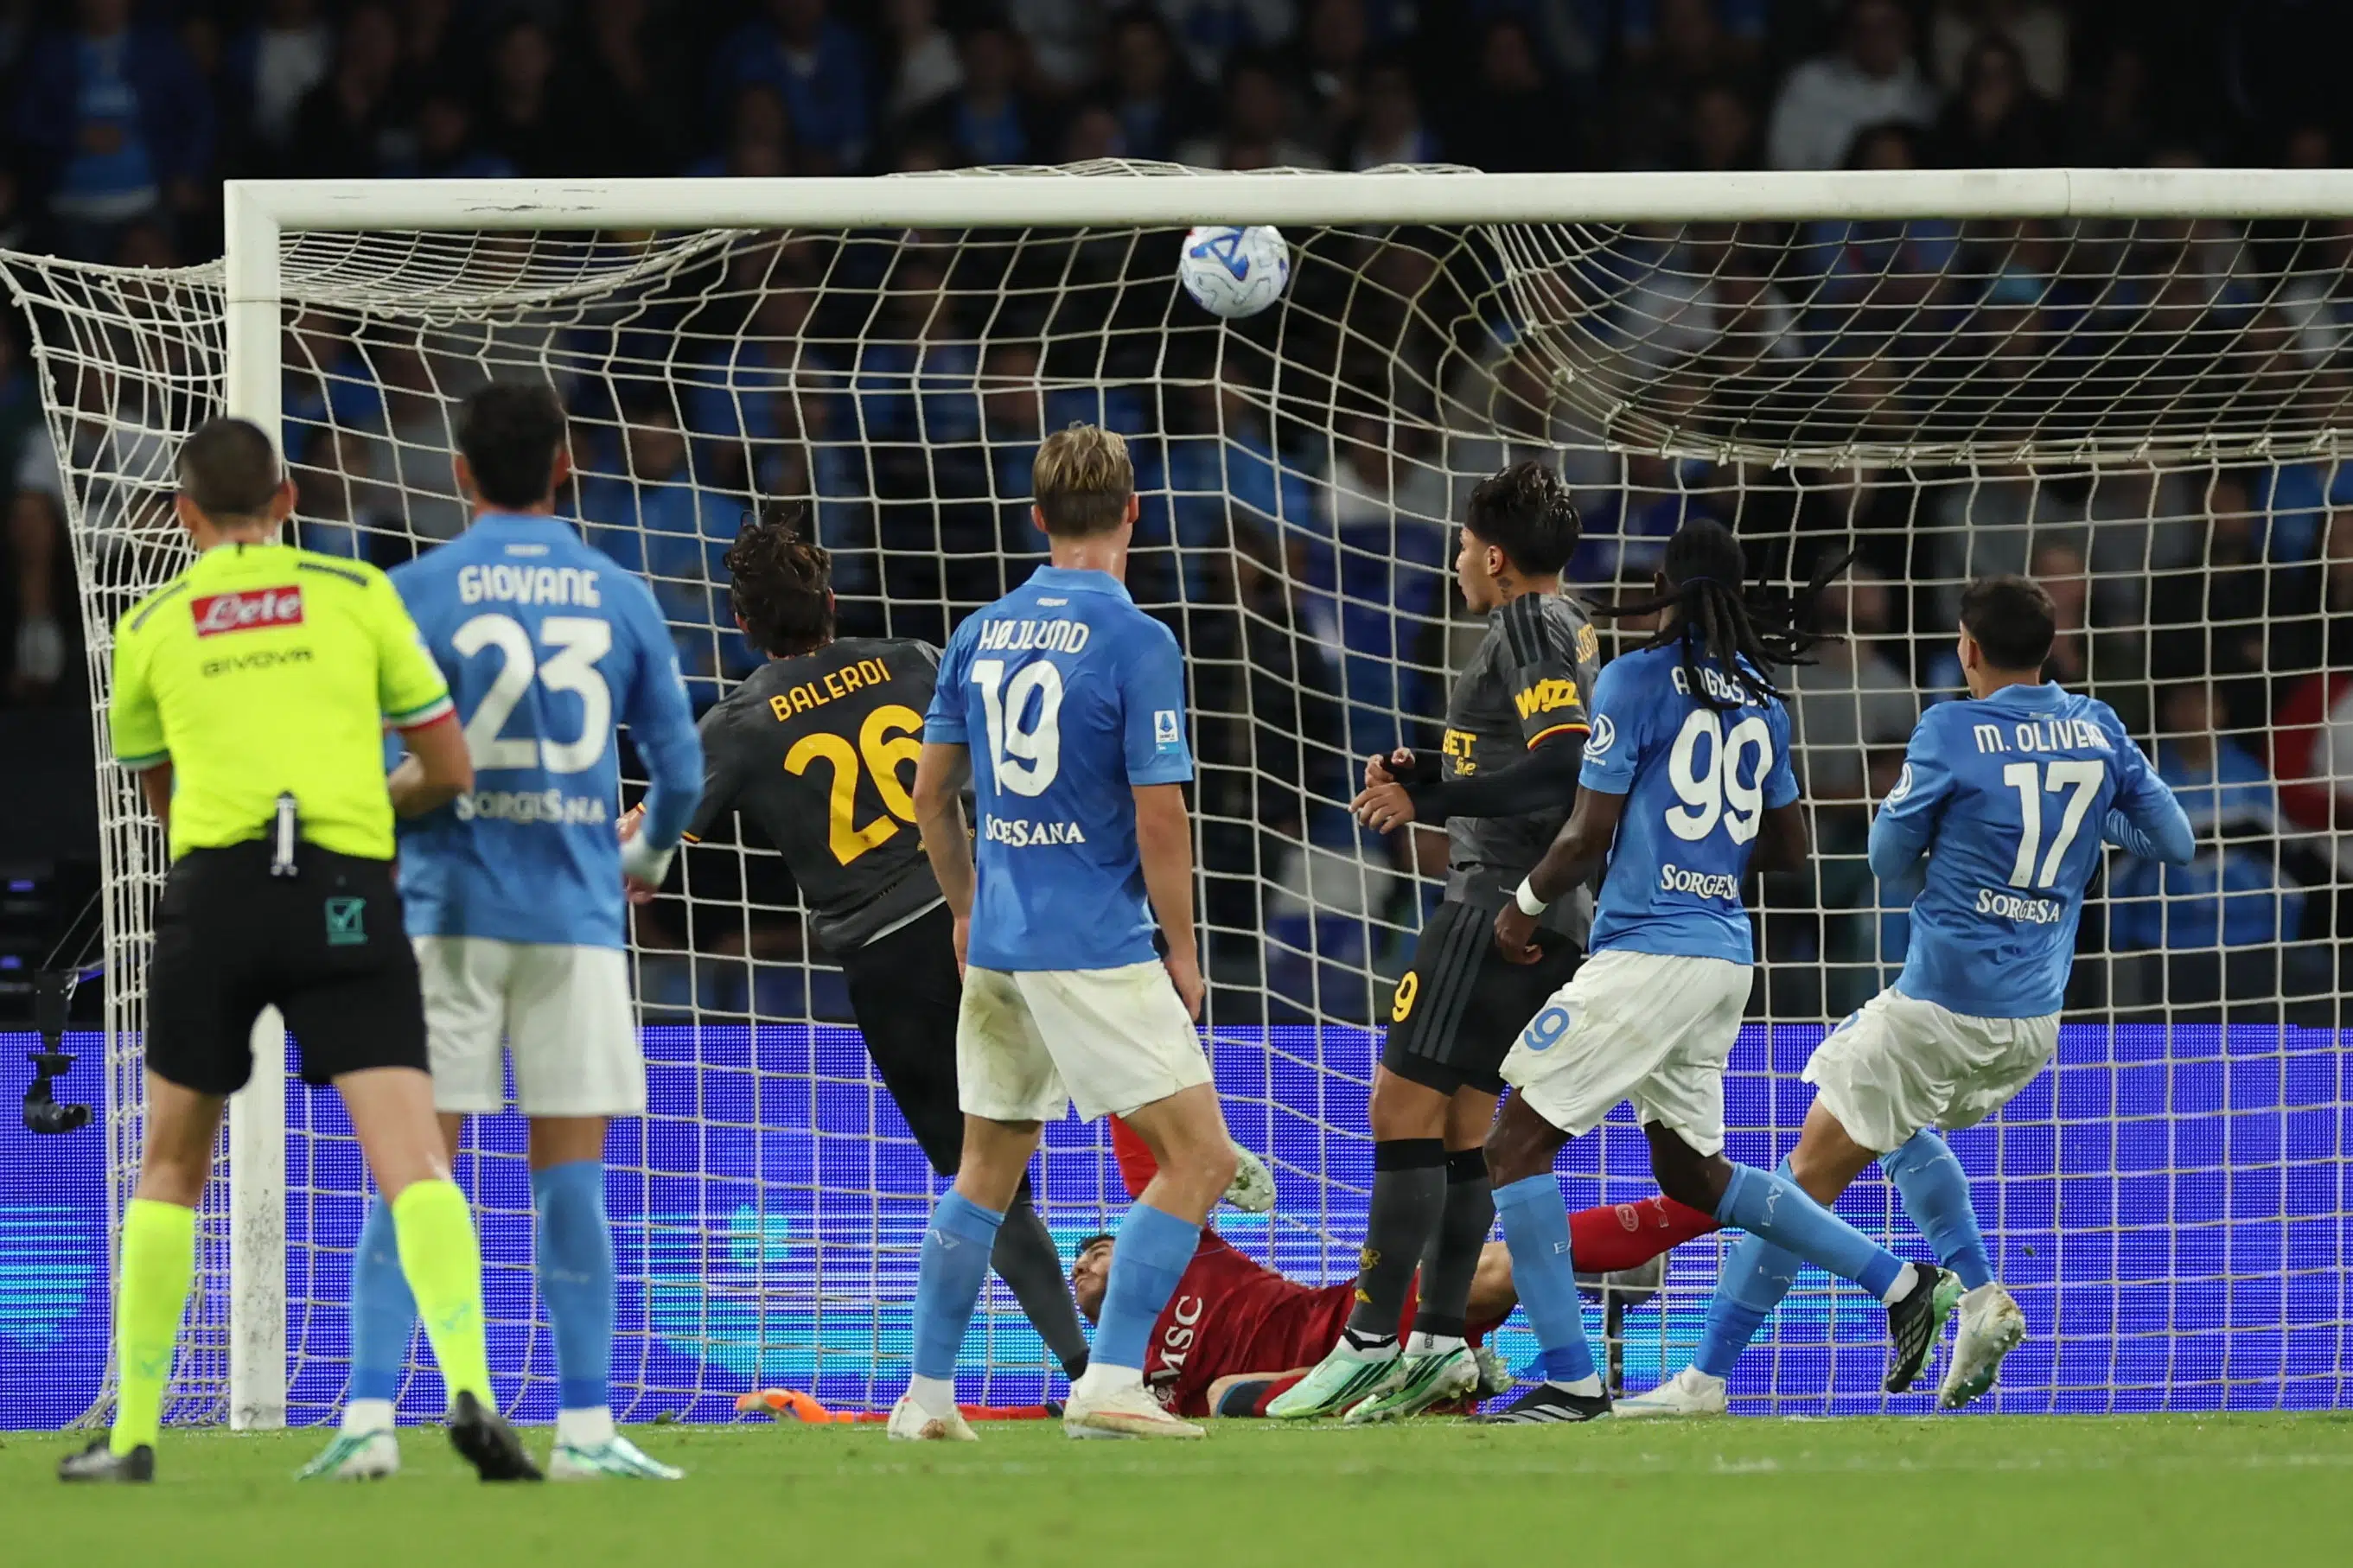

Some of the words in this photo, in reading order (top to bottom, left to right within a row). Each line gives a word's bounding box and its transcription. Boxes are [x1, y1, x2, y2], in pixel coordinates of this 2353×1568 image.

[978, 619, 1090, 654] HØJLUND
[452, 613, 612, 774] 23
[769, 658, 892, 722] BALERDI
[972, 660, 1063, 797] 19
[1666, 708, 1774, 845] 99
[1974, 724, 2012, 754] M.
[784, 704, 924, 866] 26
[2004, 760, 2104, 889] 17
[1393, 972, 1419, 1023] 9
[1524, 1007, 1570, 1051] 9
[1151, 1296, 1202, 1381] MSC
